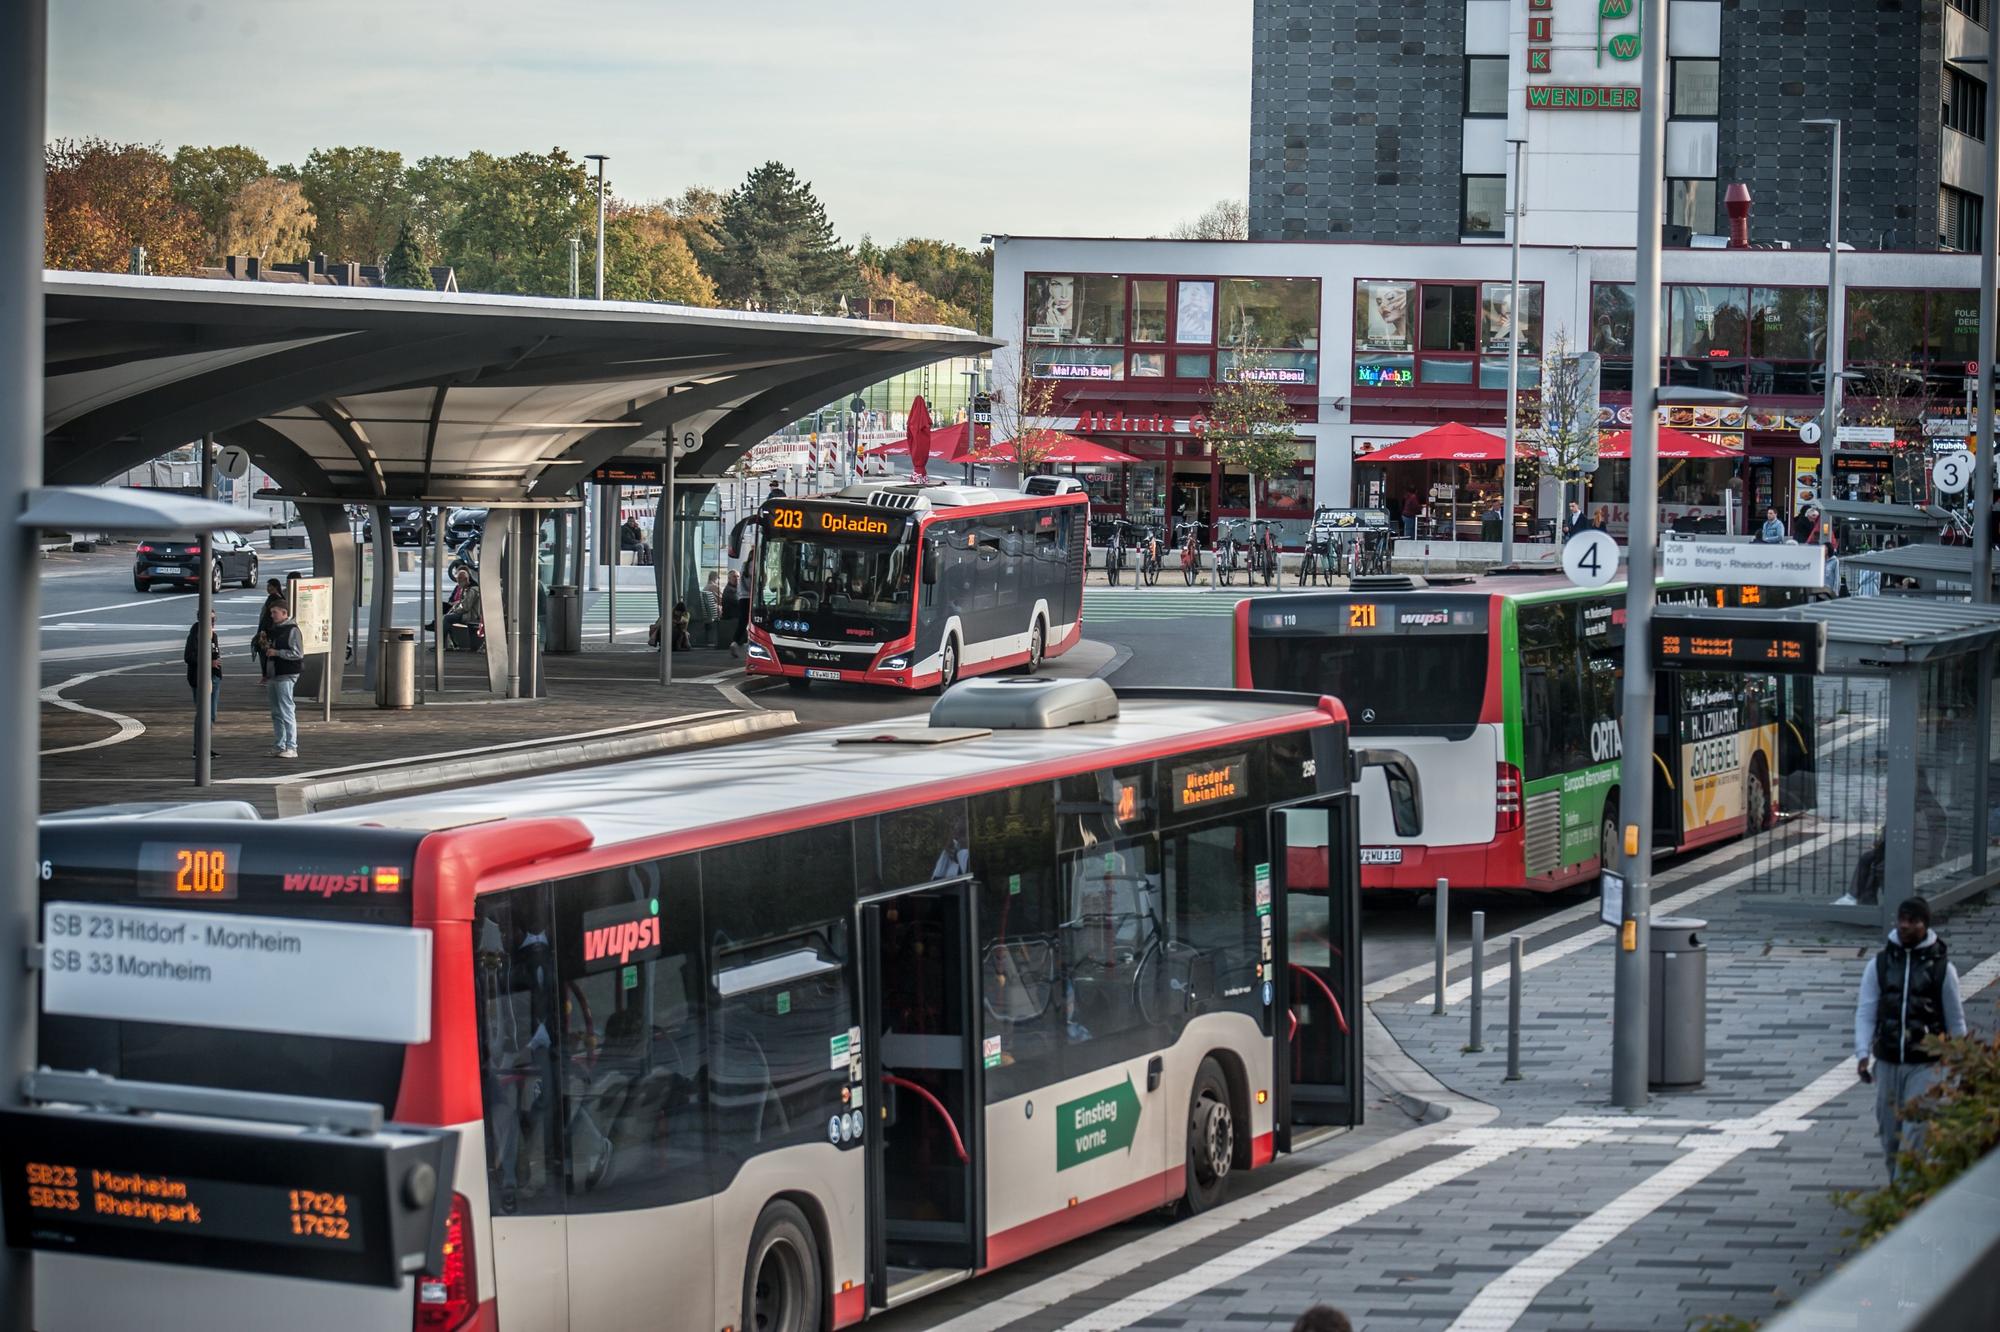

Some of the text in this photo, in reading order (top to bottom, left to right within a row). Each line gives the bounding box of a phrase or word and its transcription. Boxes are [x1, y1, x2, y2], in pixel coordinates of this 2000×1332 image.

[1613, 39, 1636, 57] W
[1529, 88, 1637, 107] WENDLER
[1074, 410, 1175, 433] Akdeniz
[684, 432, 695, 448] 6
[1807, 427, 1814, 440] 1
[226, 451, 239, 472] 7
[1944, 464, 1958, 486] 3
[774, 508, 888, 533] 203 Opladen
[1320, 512, 1356, 520] FITNESS
[1578, 542, 1601, 577] 4
[1667, 544, 1735, 554] 208 Wiesdorf
[1676, 558, 1687, 567] 23
[1695, 559, 1720, 569] Bürrig
[1730, 560, 1773, 569] Rheindorf
[1781, 562, 1811, 571] Hitdorf
[1284, 614, 1296, 625] 110
[1350, 604, 1376, 627] 211
[1400, 609, 1448, 626] wupsi
[1663, 645, 1679, 653] 208
[1691, 647, 1732, 656] Wiesdorf
[1768, 649, 1777, 657] 21
[1691, 638, 1732, 647] Wiesdorf
[1782, 641, 1800, 649] Min
[807, 652, 840, 661] MAN
[1692, 708, 1738, 740] HLZMARKT
[1691, 737, 1738, 777] GOEBEL
[1187, 766, 1230, 788] Wiesdorf
[1302, 760, 1316, 777] 296
[1183, 782, 1235, 804] Rheinallee
[176, 850, 225, 893] 208
[283, 865, 369, 898] wupsi
[52, 914, 82, 936] SB
[89, 916, 114, 939] 23
[118, 919, 185, 944] Hitdorf
[205, 926, 301, 953] Monheim
[584, 898, 660, 964] wupsi
[51, 949, 212, 982] SB 33 Monheim
[1075, 1100, 1117, 1130] Einstieg
[1075, 1128, 1107, 1153] vorne
[26, 1163, 347, 1215] SB23 Monheim 17:24
[28, 1186, 349, 1239] SB33 Rheinpark 17:32
